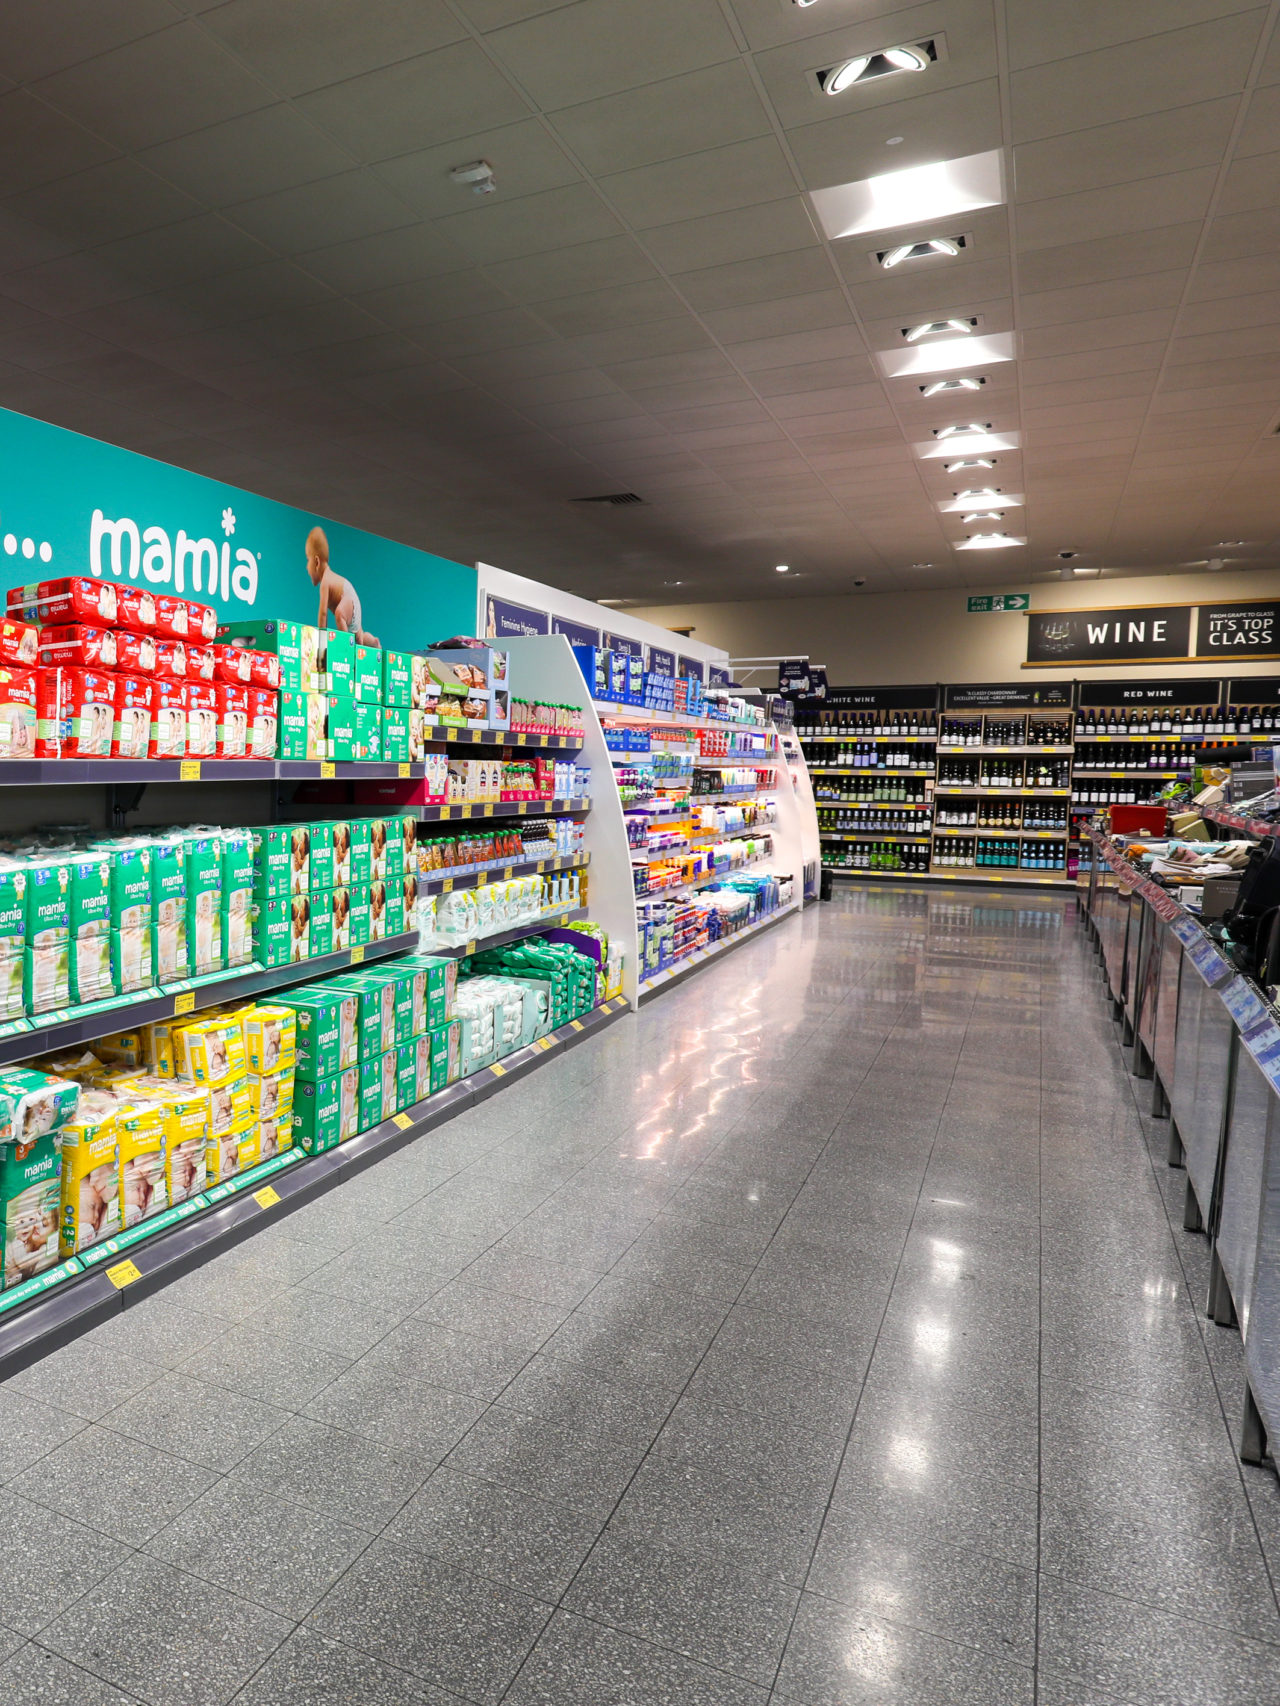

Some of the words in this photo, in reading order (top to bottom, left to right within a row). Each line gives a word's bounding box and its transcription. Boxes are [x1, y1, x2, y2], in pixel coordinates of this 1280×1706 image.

[90, 507, 258, 605] mamia
[501, 616, 520, 631] Feminine
[1087, 620, 1167, 644] WINE
[1210, 620, 1237, 631] IT'S
[1243, 618, 1273, 630] TOP
[1209, 630, 1272, 645] CLASS
[268, 848, 289, 866] mamia
[125, 876, 149, 894] mamia
[318, 1097, 338, 1119] mamia
[24, 1155, 53, 1178] mamia
